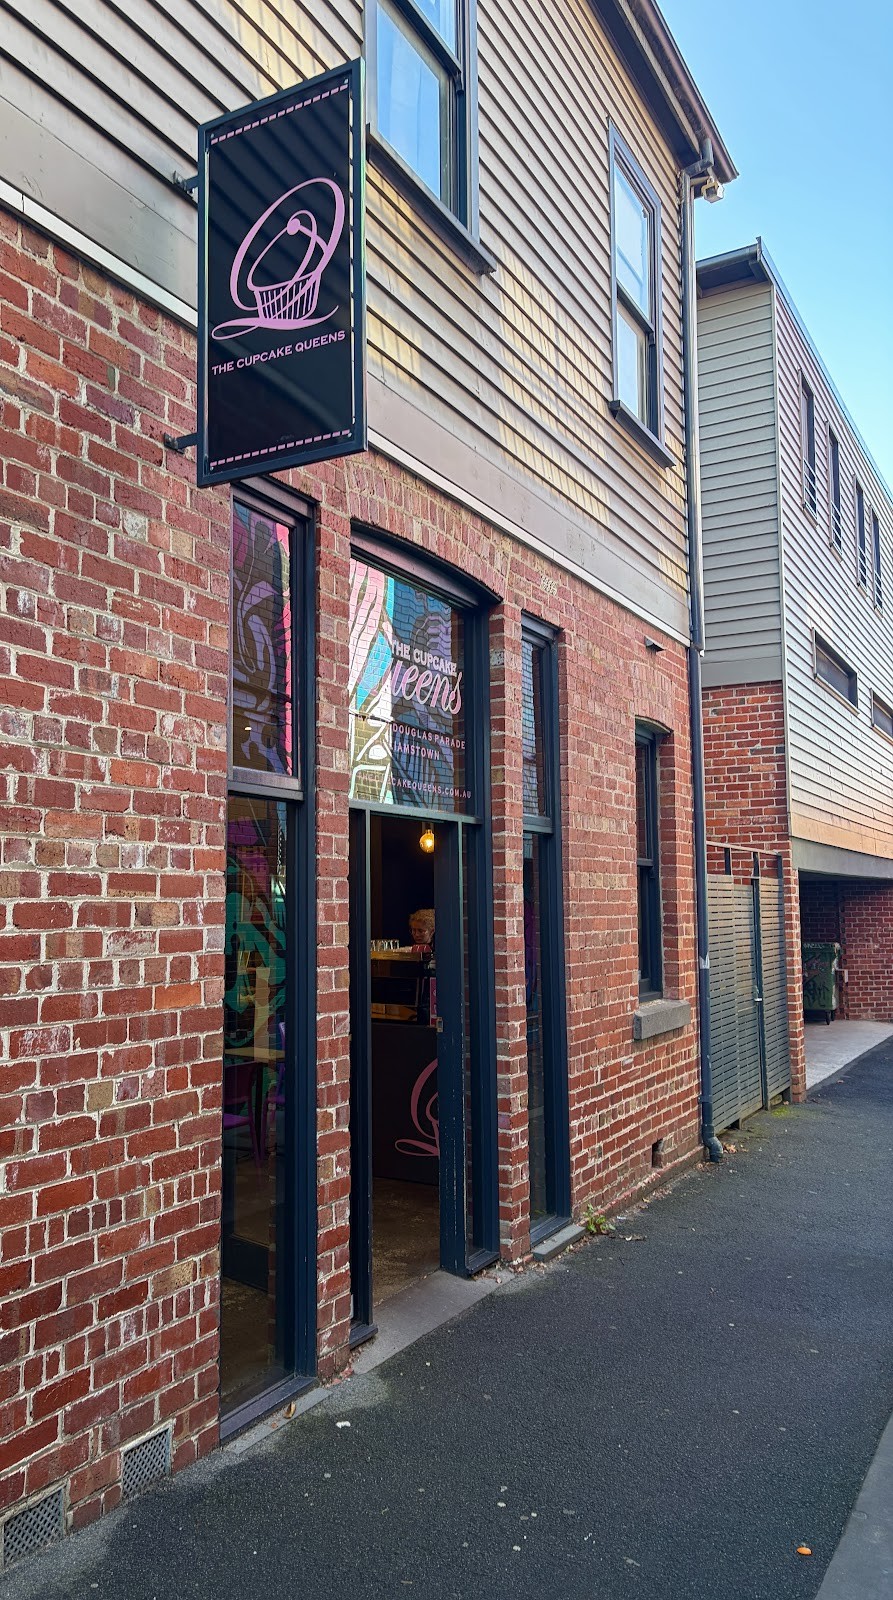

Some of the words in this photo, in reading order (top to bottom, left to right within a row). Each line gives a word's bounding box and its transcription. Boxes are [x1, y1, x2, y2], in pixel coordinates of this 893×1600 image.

[211, 361, 234, 376] THE
[236, 345, 293, 369] CUPCAKE
[295, 330, 346, 353] QUEENS
[413, 648, 457, 677] CUPCAKE
[391, 740, 440, 760] IAMSTOWN
[392, 723, 433, 742] DOUGLAS
[434, 733, 466, 750] PARADE
